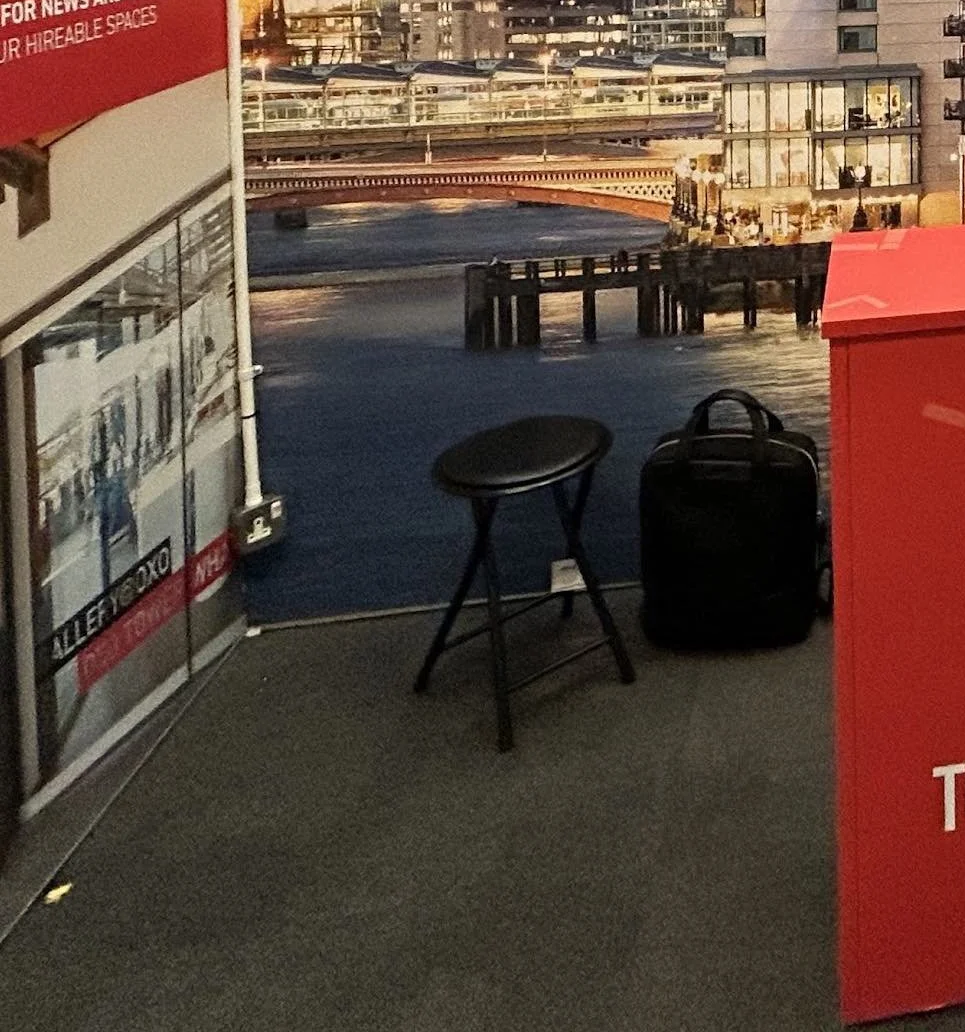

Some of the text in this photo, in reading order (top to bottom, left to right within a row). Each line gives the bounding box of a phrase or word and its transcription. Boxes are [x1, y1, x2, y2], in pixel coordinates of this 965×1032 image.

[1, 0, 37, 27] FOR
[25, 17, 102, 56] HIREABLE
[106, 5, 158, 36] SPACES
